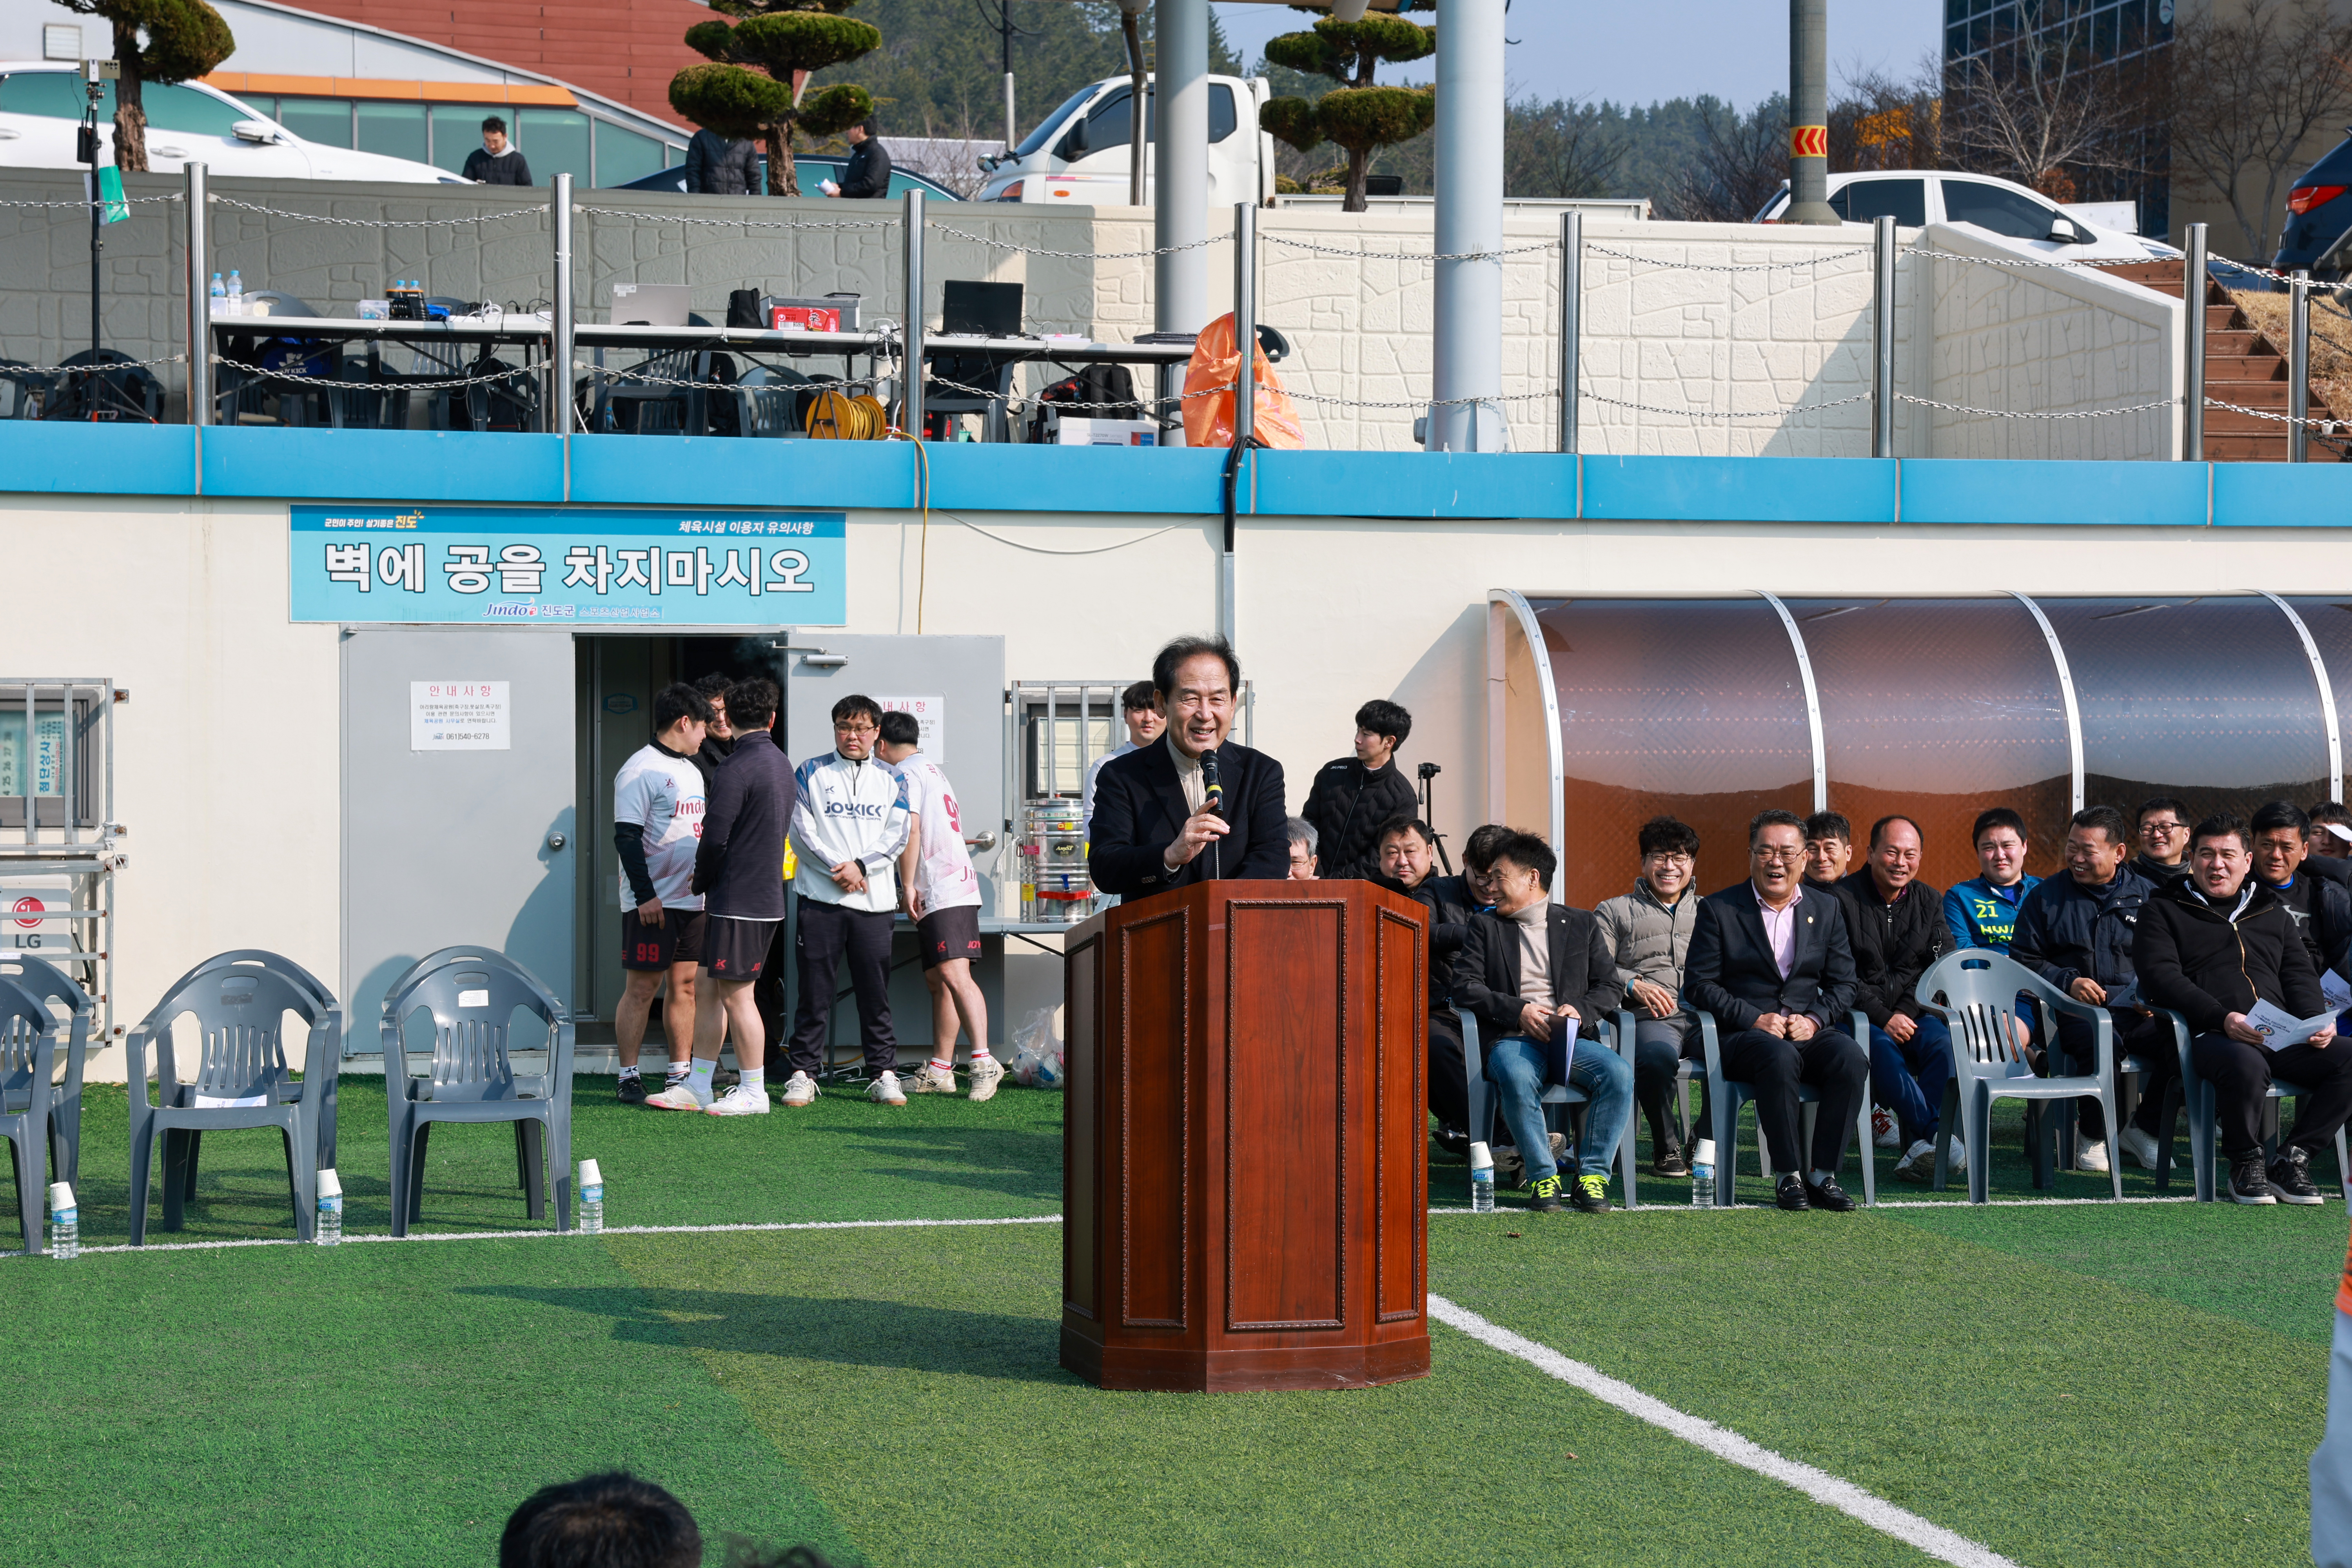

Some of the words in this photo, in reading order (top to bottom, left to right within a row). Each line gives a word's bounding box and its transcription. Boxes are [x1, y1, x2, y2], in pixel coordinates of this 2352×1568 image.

[325, 519, 346, 527] 군민이
[347, 519, 364, 527] 주인!
[366, 519, 394, 528] 살기좋은
[395, 515, 417, 528] 진도
[679, 521, 726, 534] 체육시설
[729, 521, 764, 534] 이용자
[767, 522, 814, 535] 유의사항
[325, 543, 425, 593] 벽에
[443, 544, 546, 594] 공을
[561, 545, 815, 596] 차지마시오
[483, 603, 527, 616] Jindo
[541, 604, 575, 617] 진도군
[579, 606, 661, 618] 스포츠산업사업소
[3, 761, 11, 771] 26
[39, 741, 51, 792] 첨단상사
[3, 775, 11, 786] 25
[1976, 904, 1998, 918] 21
[15, 934, 41, 949] LG
[637, 943, 660, 962] 99
